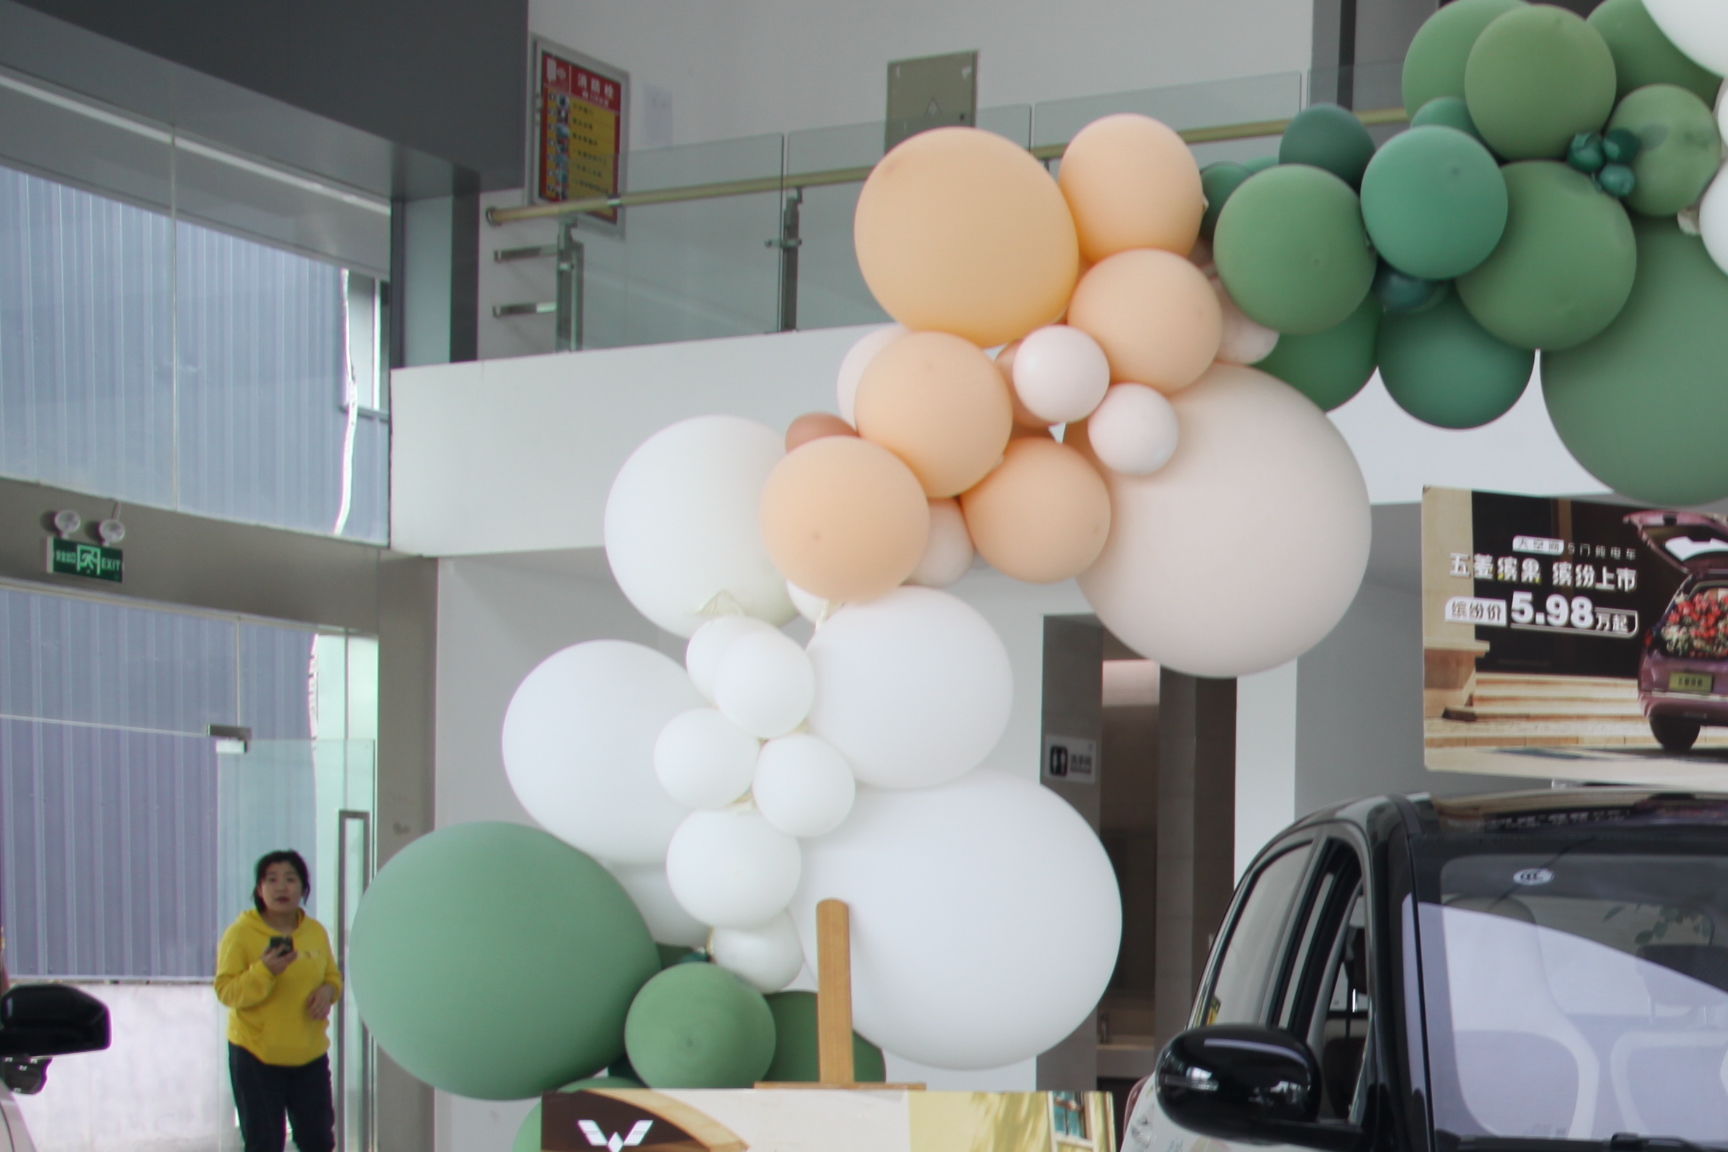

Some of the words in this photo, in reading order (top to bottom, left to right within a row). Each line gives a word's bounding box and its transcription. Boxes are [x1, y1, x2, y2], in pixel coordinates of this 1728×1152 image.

[101, 557, 121, 571] EXIT
[1449, 552, 1542, 584] 五菱缤果
[1552, 560, 1637, 592] 缤纷上市
[1452, 600, 1502, 622] 缤纷价
